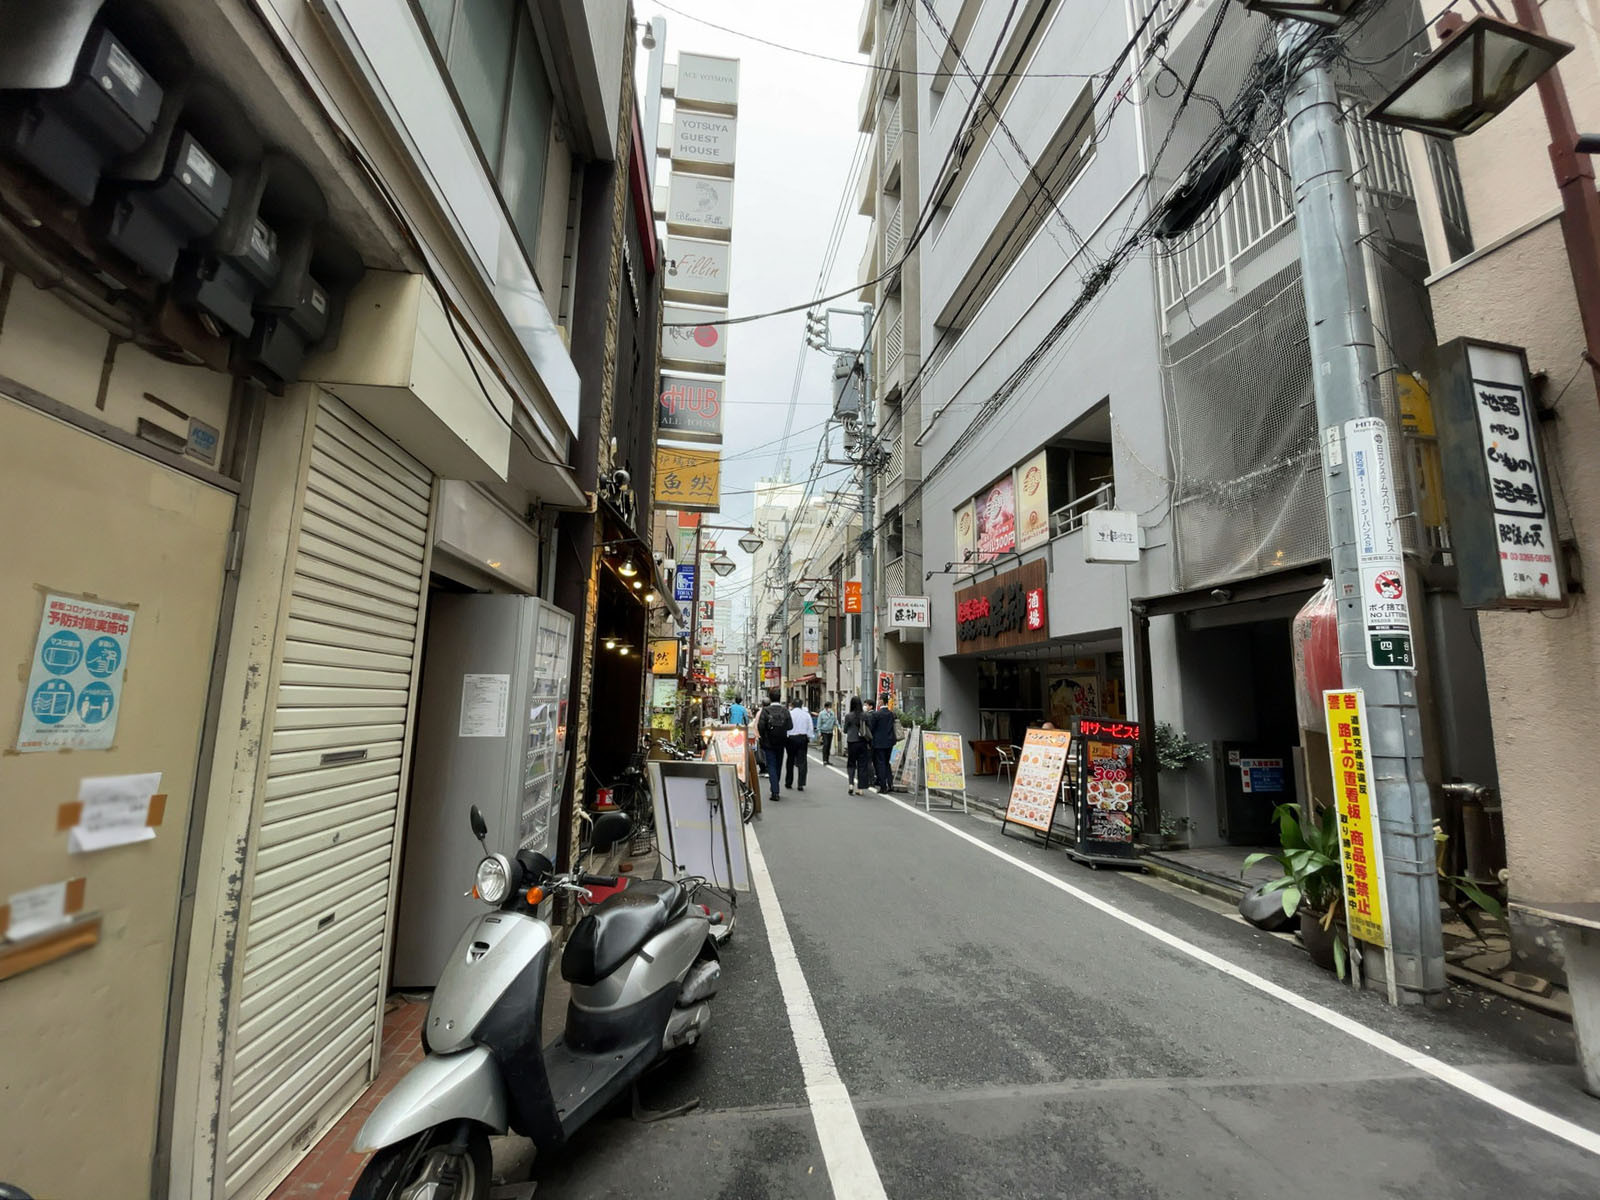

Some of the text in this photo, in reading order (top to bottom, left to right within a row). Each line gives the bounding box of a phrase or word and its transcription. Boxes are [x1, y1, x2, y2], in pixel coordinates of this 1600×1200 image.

[700, 72, 734, 84] YOTSUYA
[681, 120, 729, 132] YOTSUYA
[680, 132, 719, 144] GUEST
[679, 144, 720, 156] HOUSE
[660, 384, 720, 419] HUB
[661, 416, 681, 425] ALE
[1028, 590, 1040, 628] 酒場
[48, 610, 129, 635] 予防対策実施中
[1388, 653, 1410, 663] 1-8
[1328, 694, 1356, 710] 警告
[1351, 715, 1368, 794] 道路交通法違反
